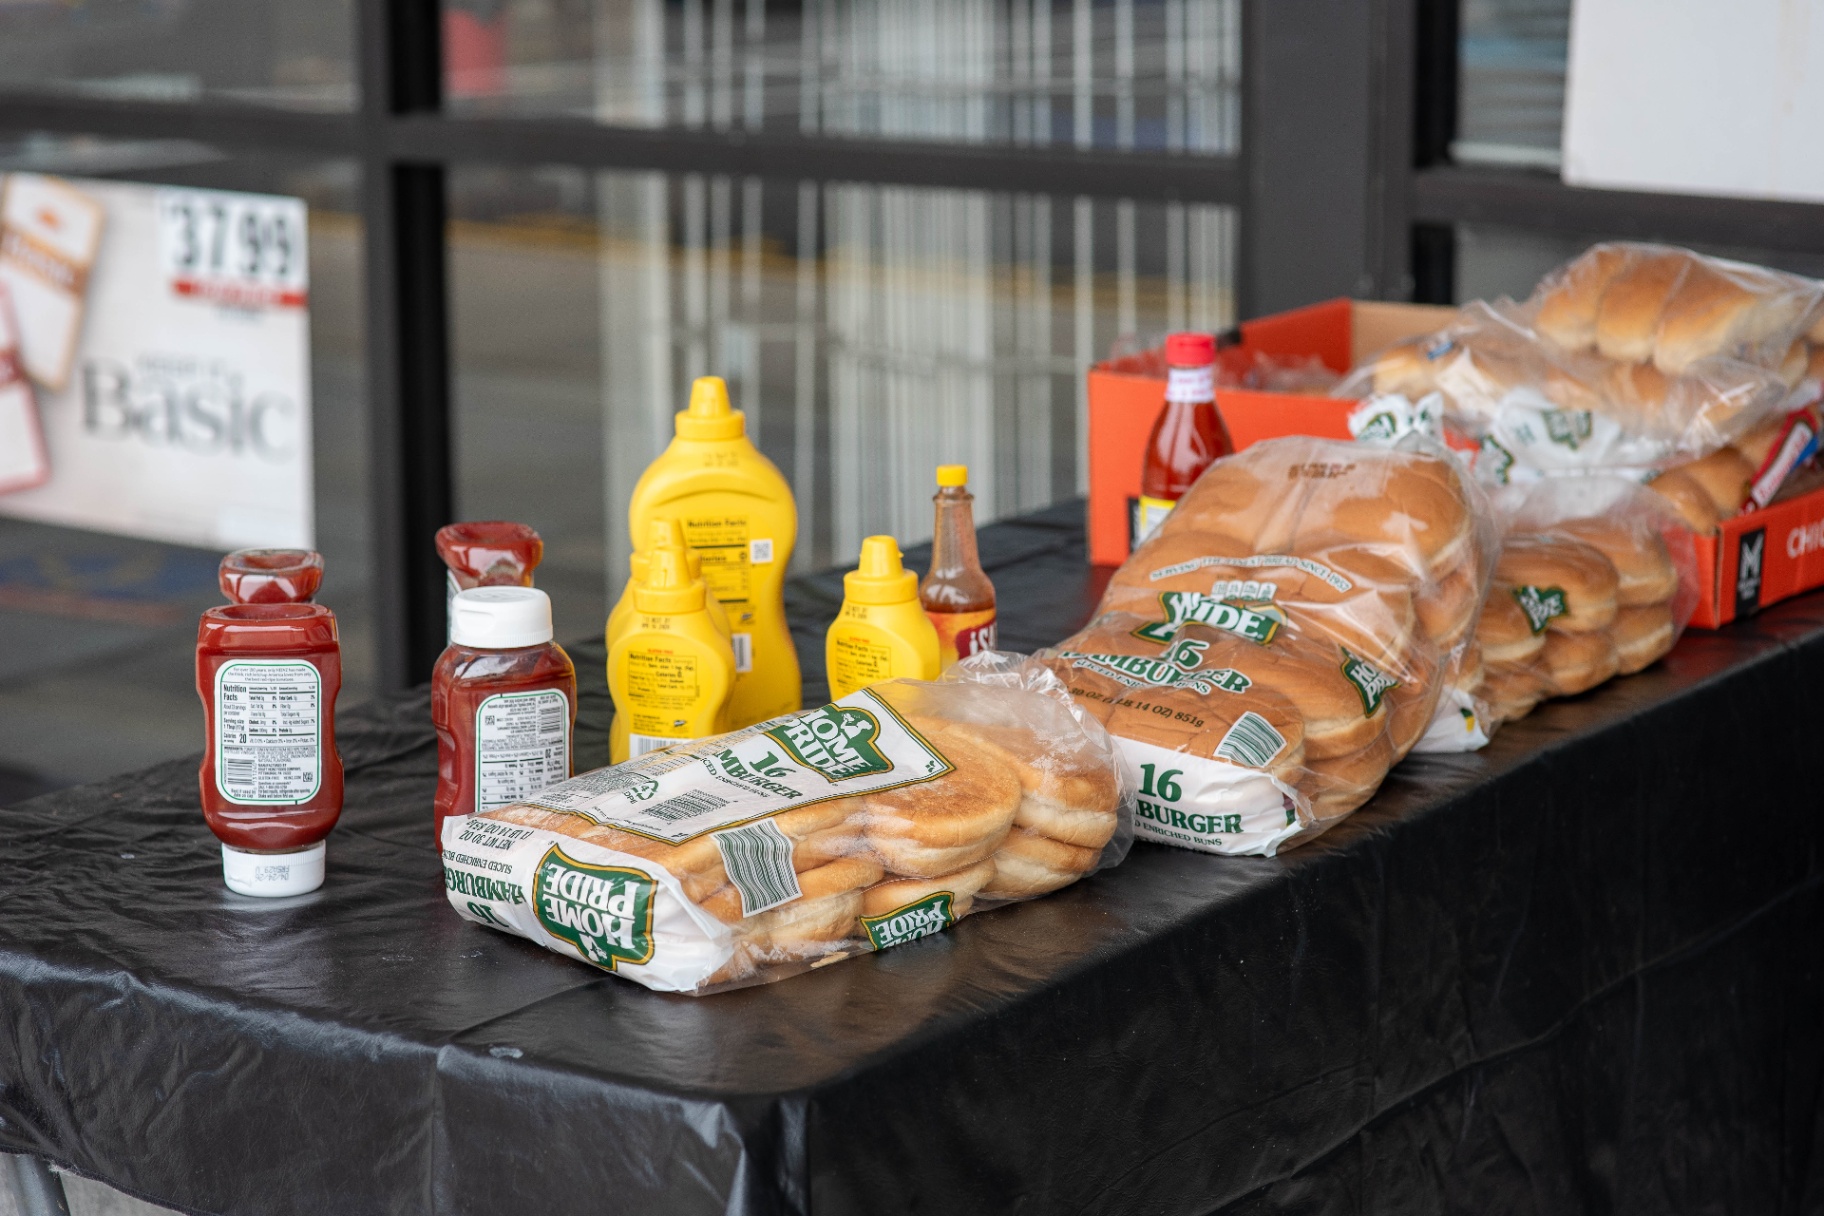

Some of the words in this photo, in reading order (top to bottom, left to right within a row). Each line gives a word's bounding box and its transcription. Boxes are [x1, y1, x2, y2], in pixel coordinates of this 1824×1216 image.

[80, 356, 298, 466] Basic
[1787, 518, 1824, 559] CHI
[1301, 560, 1326, 579] SINCE
[630, 653, 653, 661] Nutrition
[224, 684, 246, 692] Nutrition
[1135, 701, 1151, 712] 14
[1152, 705, 1173, 718] OZ)
[1174, 711, 1205, 728] 851g
[239, 734, 246, 744] 20
[749, 751, 796, 778] 16
[713, 748, 804, 800] MBURGER
[1138, 763, 1184, 803] 16
[622, 790, 638, 804] DPE
[1136, 799, 1244, 834] BURGER
[458, 830, 474, 842] OZ
[484, 822, 501, 834] OZ)
[497, 827, 512, 837] 14
[508, 830, 523, 839] LB
[1143, 822, 1191, 841] ENRICHED
[1194, 836, 1222, 846] BUNS
[472, 834, 486, 844] 30
[482, 836, 500, 850] WT
[495, 839, 516, 850] NET
[456, 854, 488, 869] ENRICHED
[488, 860, 512, 874] SLICED
[443, 866, 526, 905] HAMBURG
[542, 862, 641, 920] PRIDE
[544, 893, 636, 950] HOME
[874, 900, 946, 944] PRIDE
